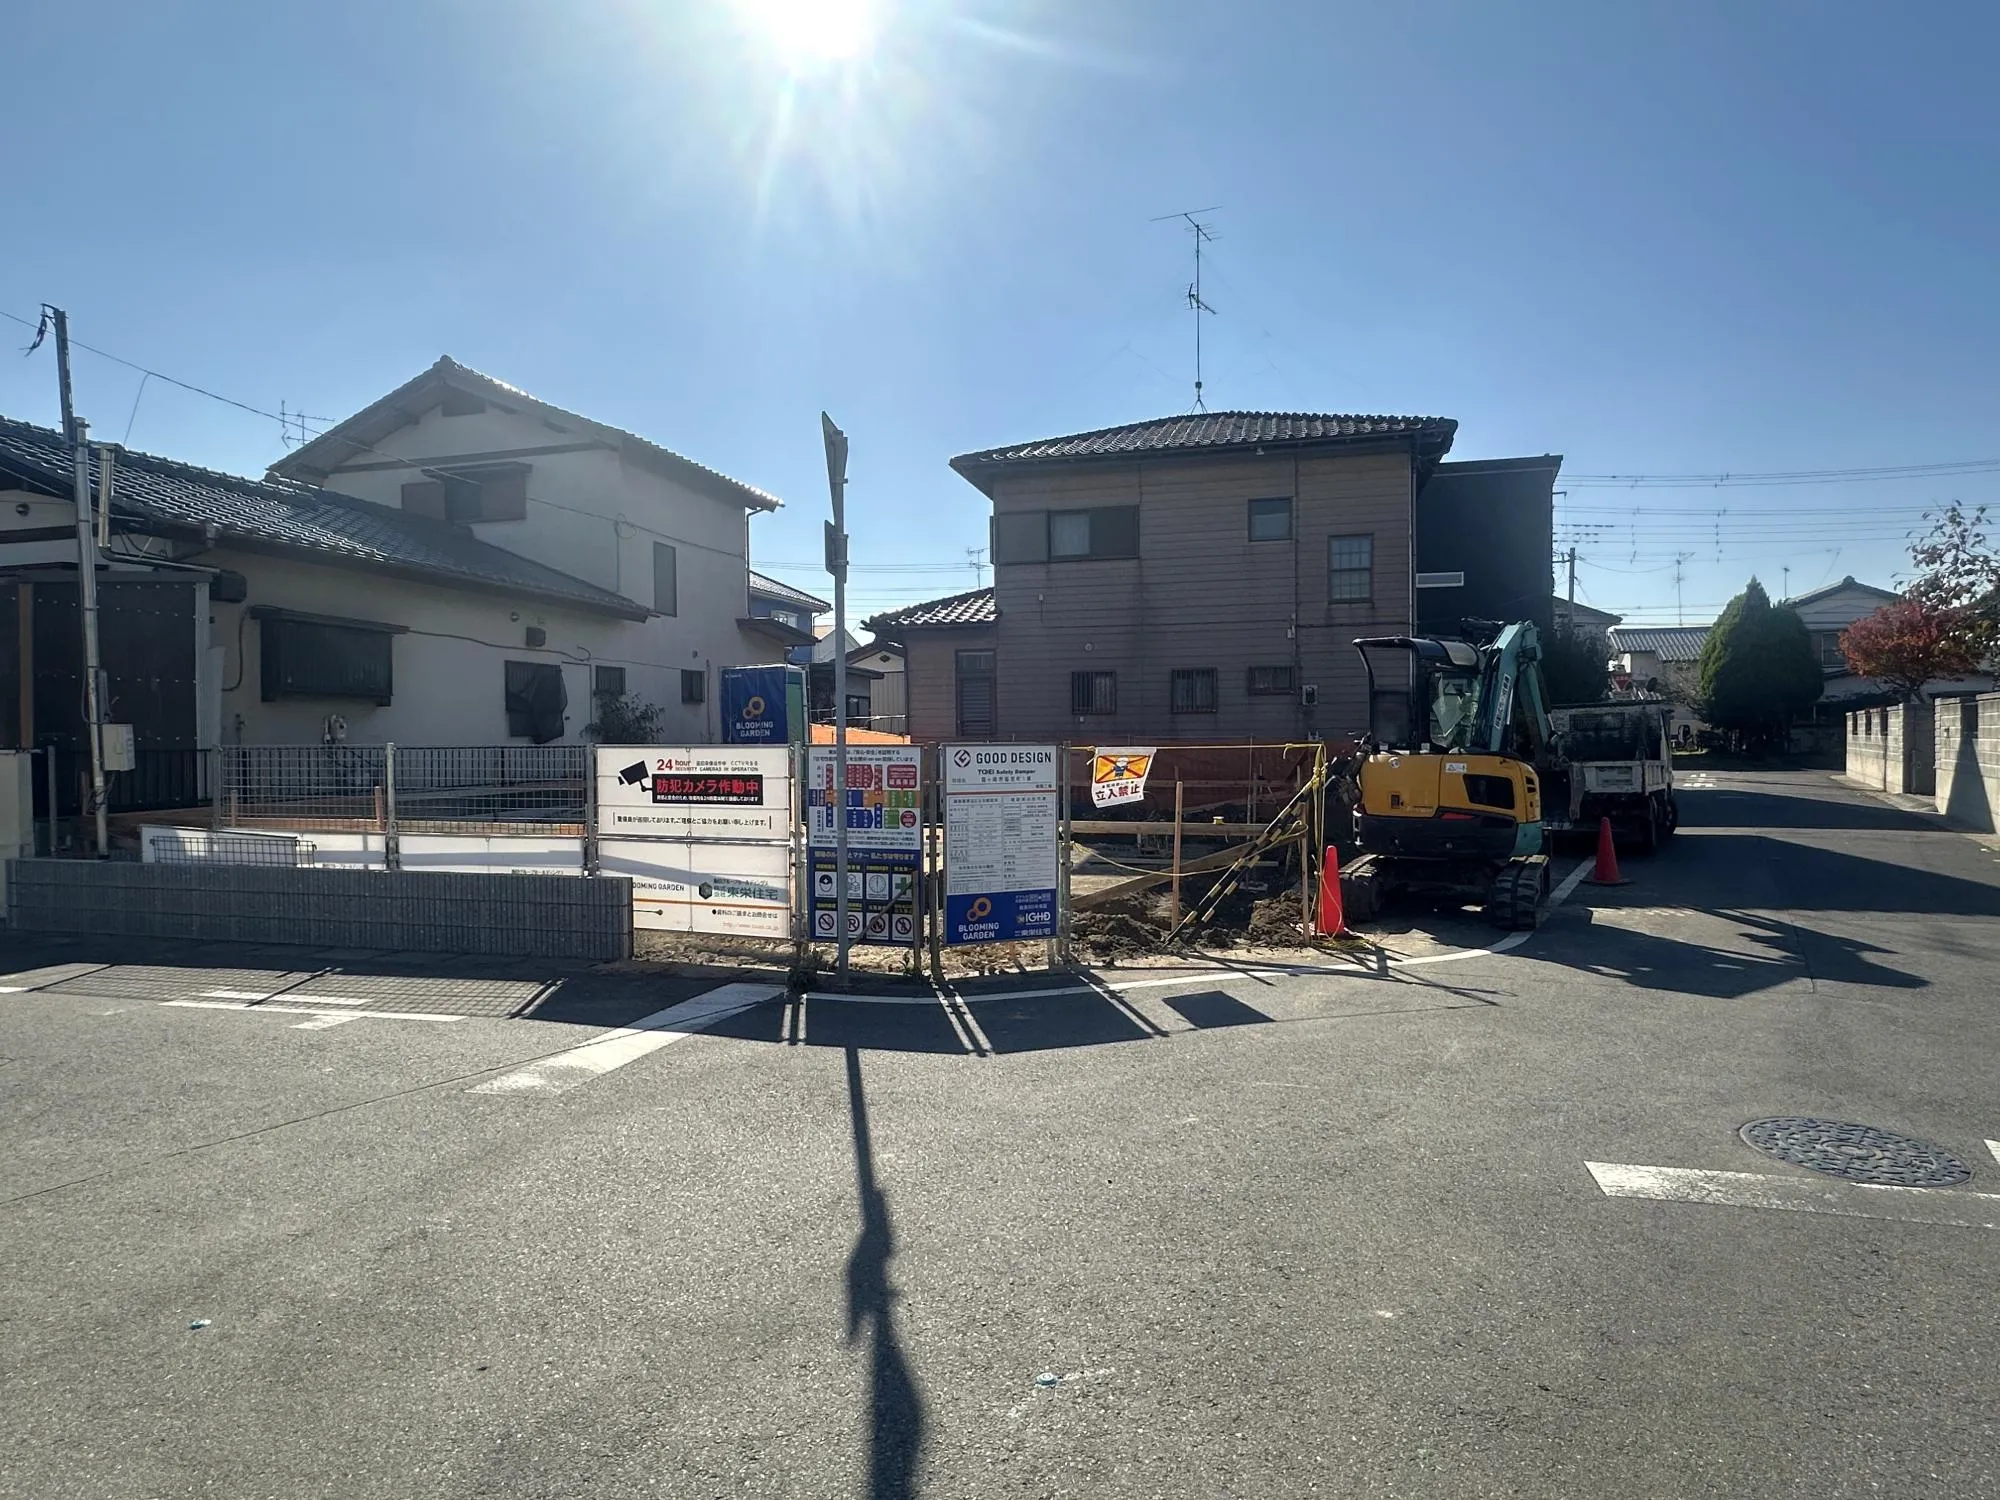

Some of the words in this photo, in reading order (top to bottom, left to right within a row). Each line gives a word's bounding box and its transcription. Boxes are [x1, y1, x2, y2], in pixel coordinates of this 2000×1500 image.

[736, 721, 774, 730] BLOOMING
[740, 729, 770, 737] GARDEN
[976, 752, 1007, 764] GOOD
[1011, 752, 1052, 763] DESIGN
[656, 759, 673, 771] 24
[656, 778, 759, 795] 防犯カメラ作動中
[1095, 784, 1140, 801] 立入禁止
[658, 883, 685, 892] GARDEN
[727, 887, 779, 901] 東栄住宅
[958, 922, 1000, 933] BLOOMING
[962, 931, 995, 941] GARDEN
